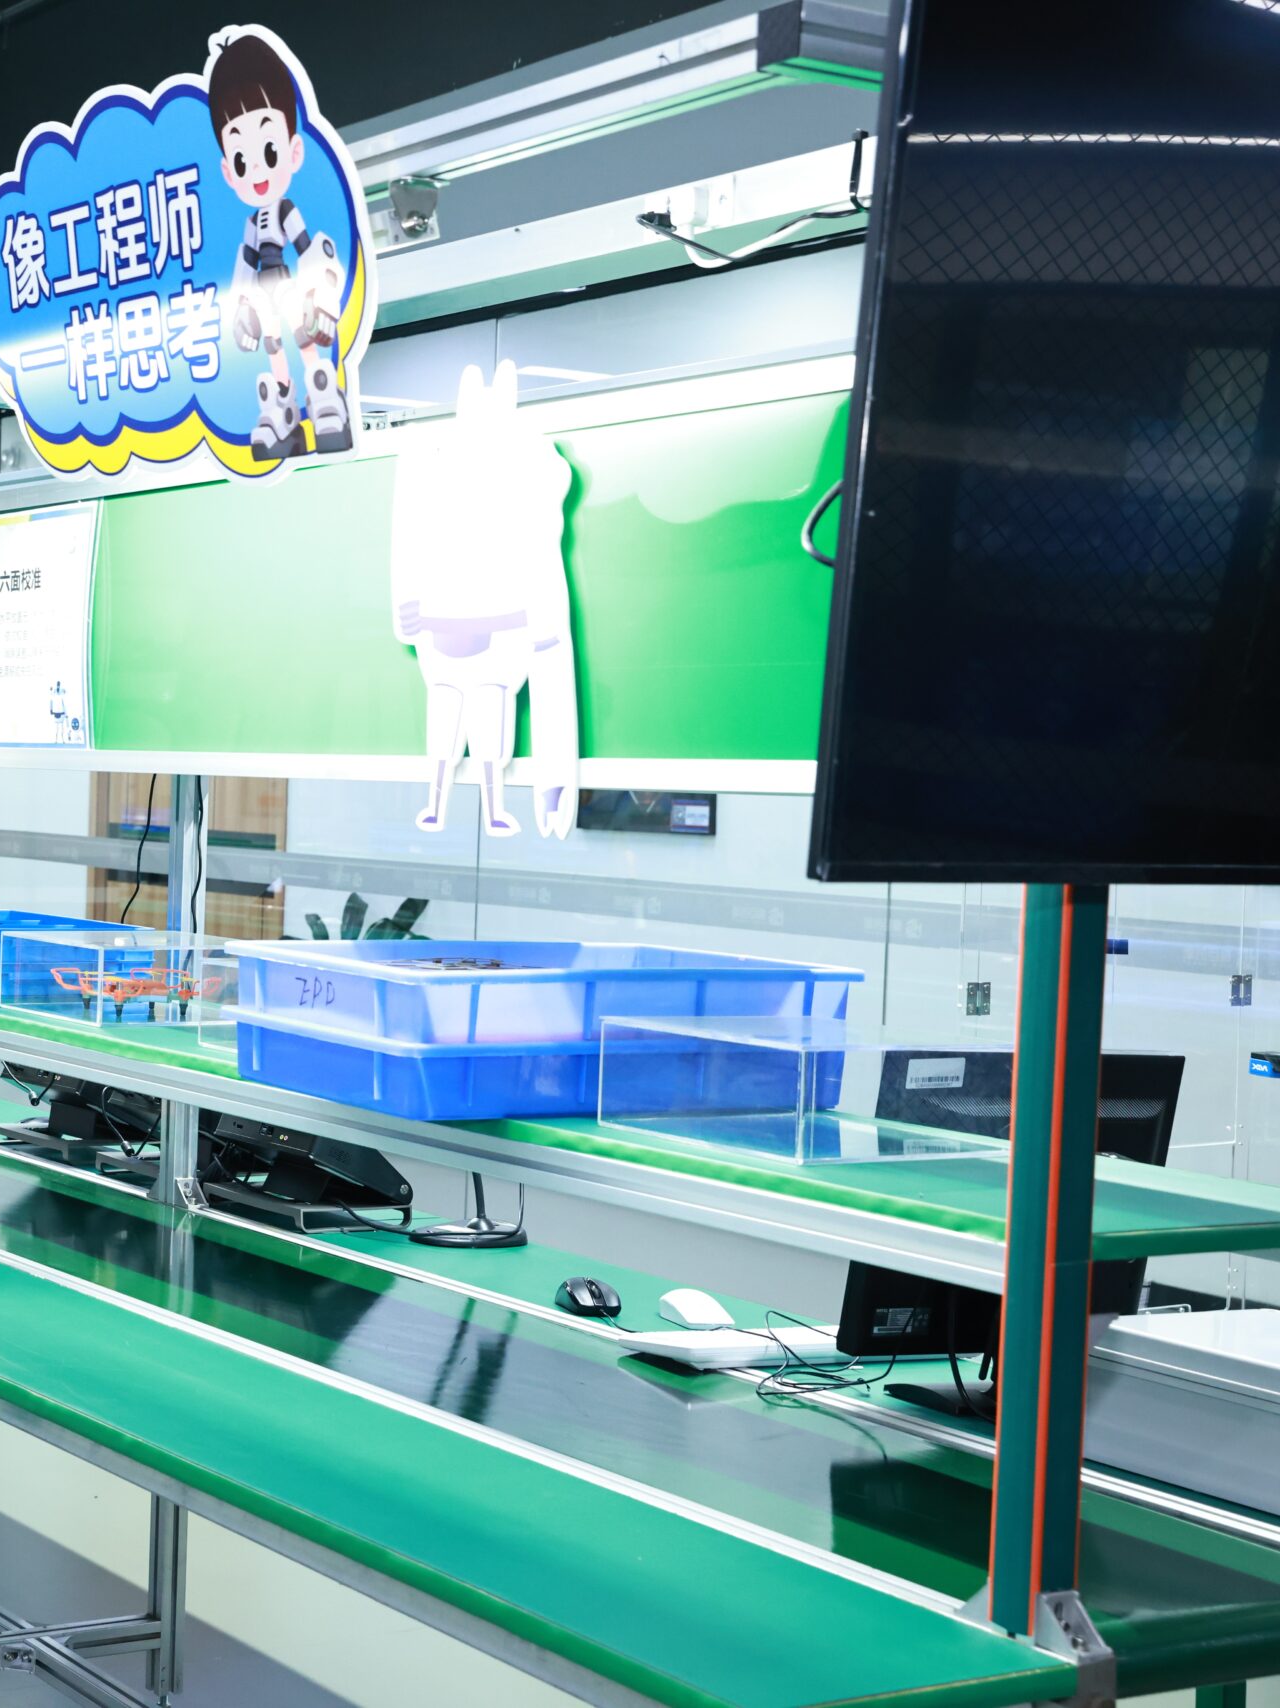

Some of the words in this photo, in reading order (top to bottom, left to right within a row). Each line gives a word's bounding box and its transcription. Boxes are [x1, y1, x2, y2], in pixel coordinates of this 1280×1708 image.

[2, 165, 202, 311] 像工程师
[21, 281, 220, 402] 一样思考
